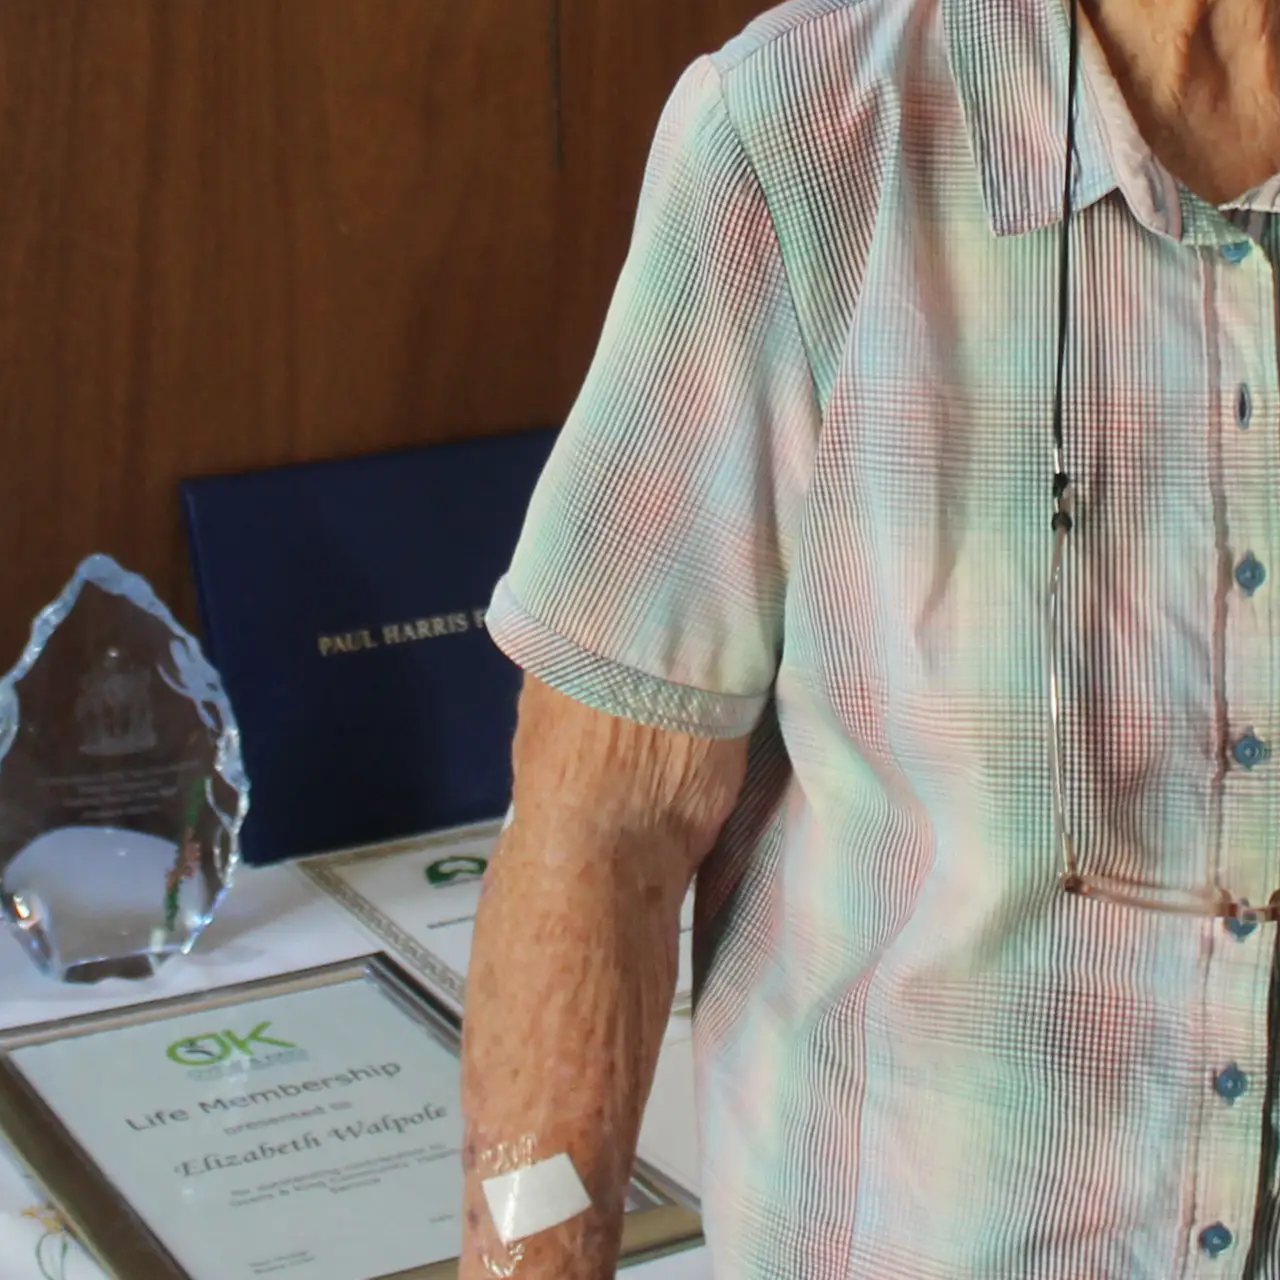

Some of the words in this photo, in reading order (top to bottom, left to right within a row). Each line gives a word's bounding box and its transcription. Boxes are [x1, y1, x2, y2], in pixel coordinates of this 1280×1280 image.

[317, 630, 379, 657] PAUL
[382, 612, 469, 645] HARRIS
[124, 1107, 190, 1133] Life
[198, 1060, 402, 1115] Membership
[174, 1131, 321, 1178] Elizabeth
[327, 1102, 448, 1143] Walpole
